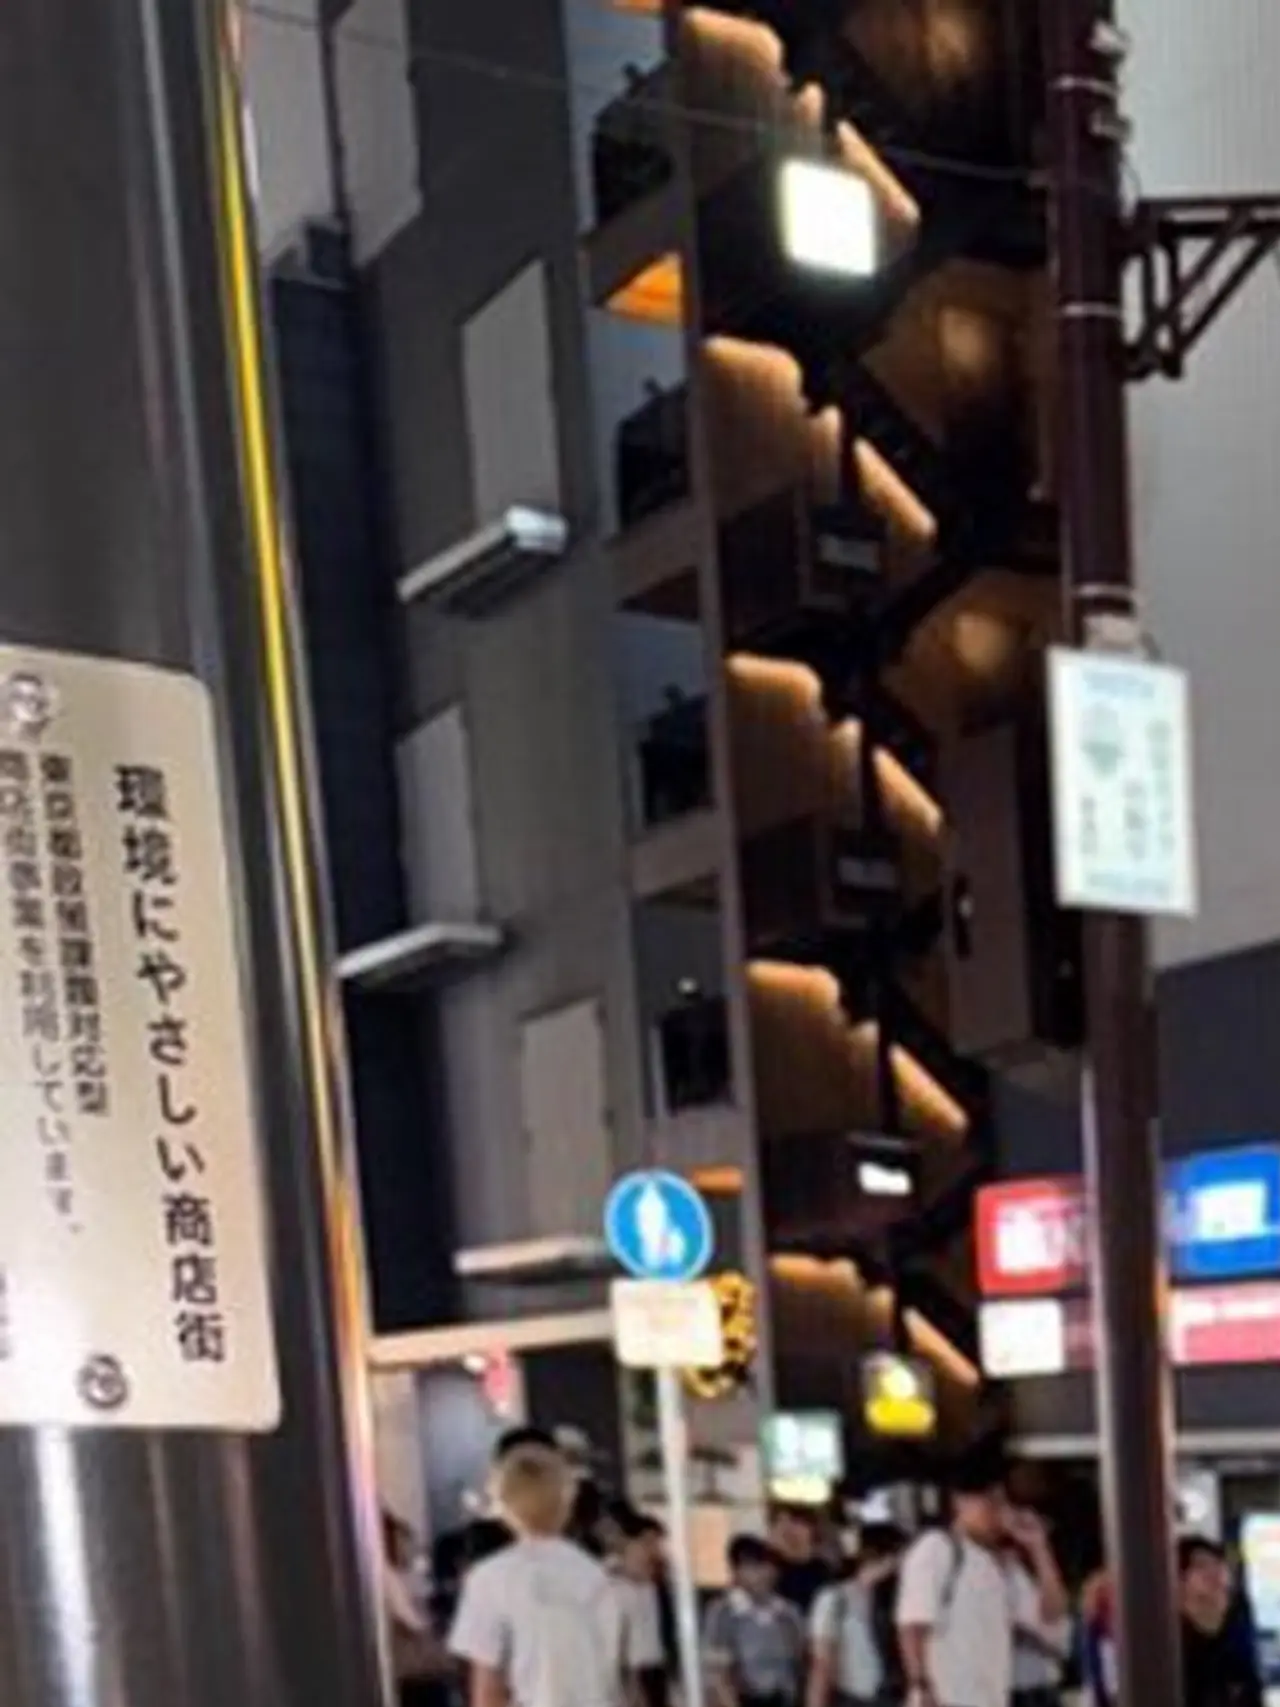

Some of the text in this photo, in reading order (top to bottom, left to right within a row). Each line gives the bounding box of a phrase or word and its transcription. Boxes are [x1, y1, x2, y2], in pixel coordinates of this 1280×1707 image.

[114, 764, 224, 1363] 環境にやさしい商店街
